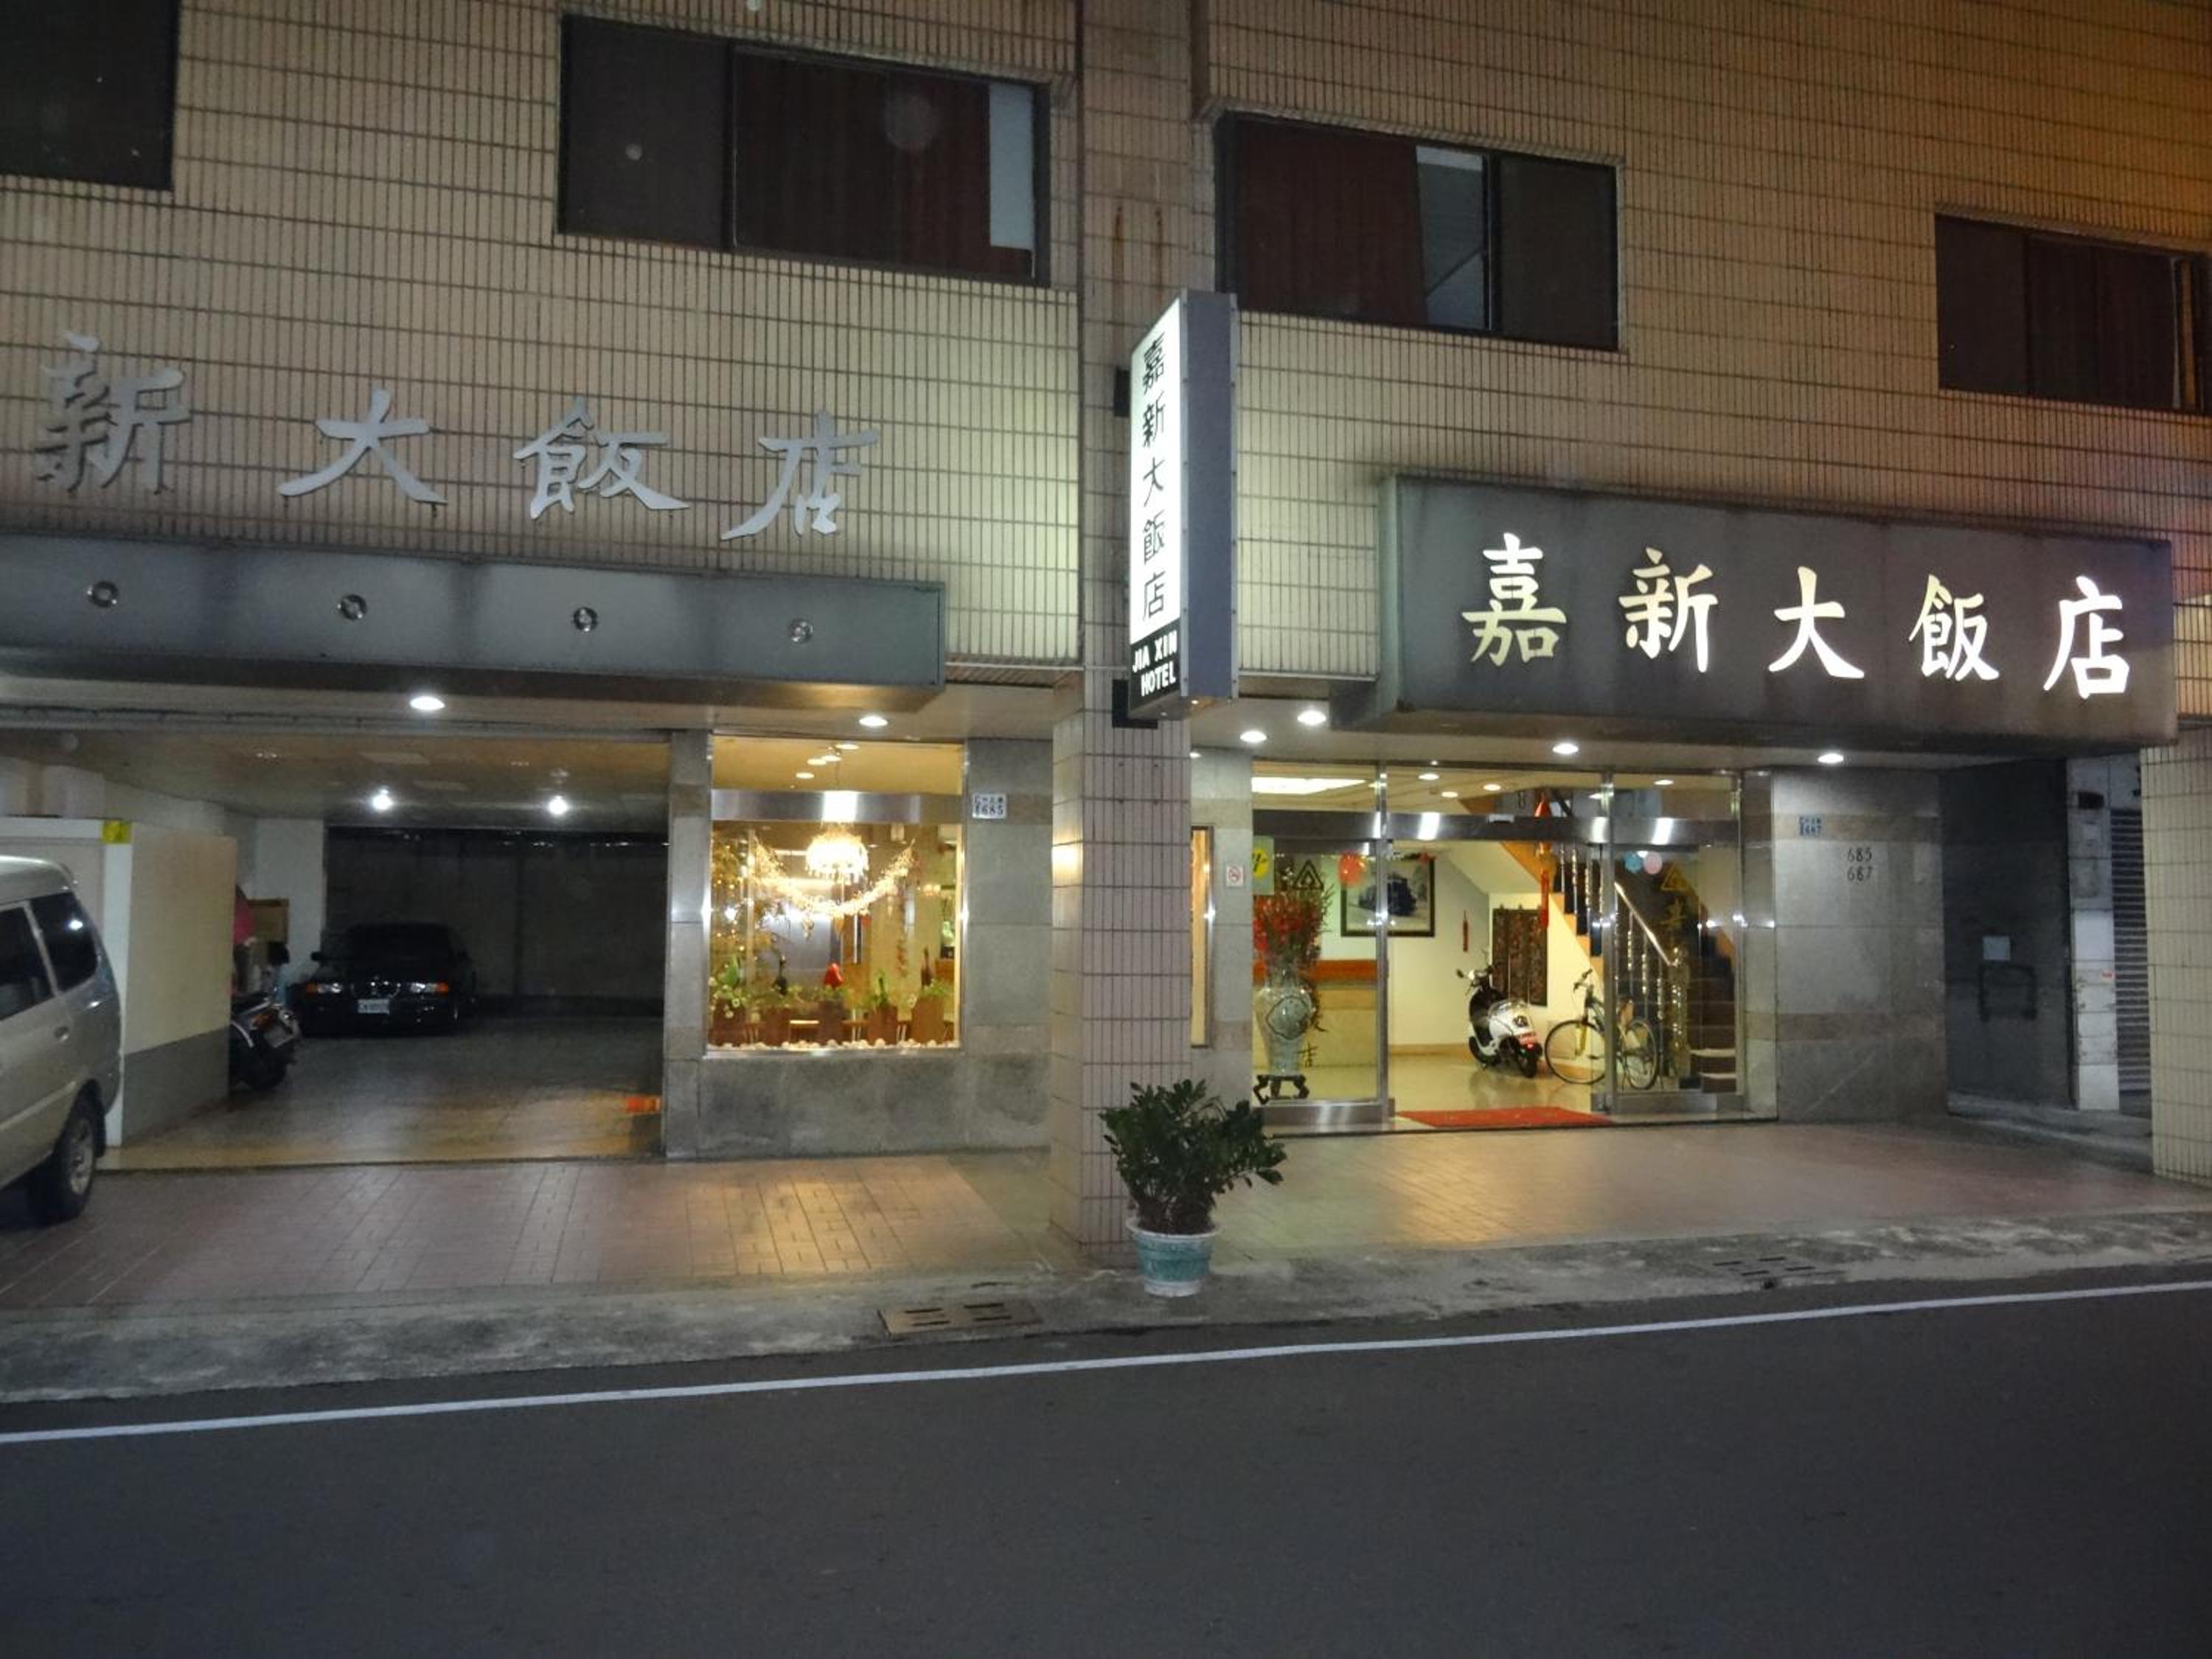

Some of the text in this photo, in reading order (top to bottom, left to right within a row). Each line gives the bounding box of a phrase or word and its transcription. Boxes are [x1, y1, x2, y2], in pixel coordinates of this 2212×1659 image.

[36, 330, 879, 540] 新大飯店
[1142, 332, 1166, 622] 嘉新大飯店
[1133, 630, 1178, 672] JIA XIN
[1461, 532, 2132, 700] 嘉新大飯店
[1141, 661, 1176, 696] HOTEL
[1847, 847, 1873, 862] 685
